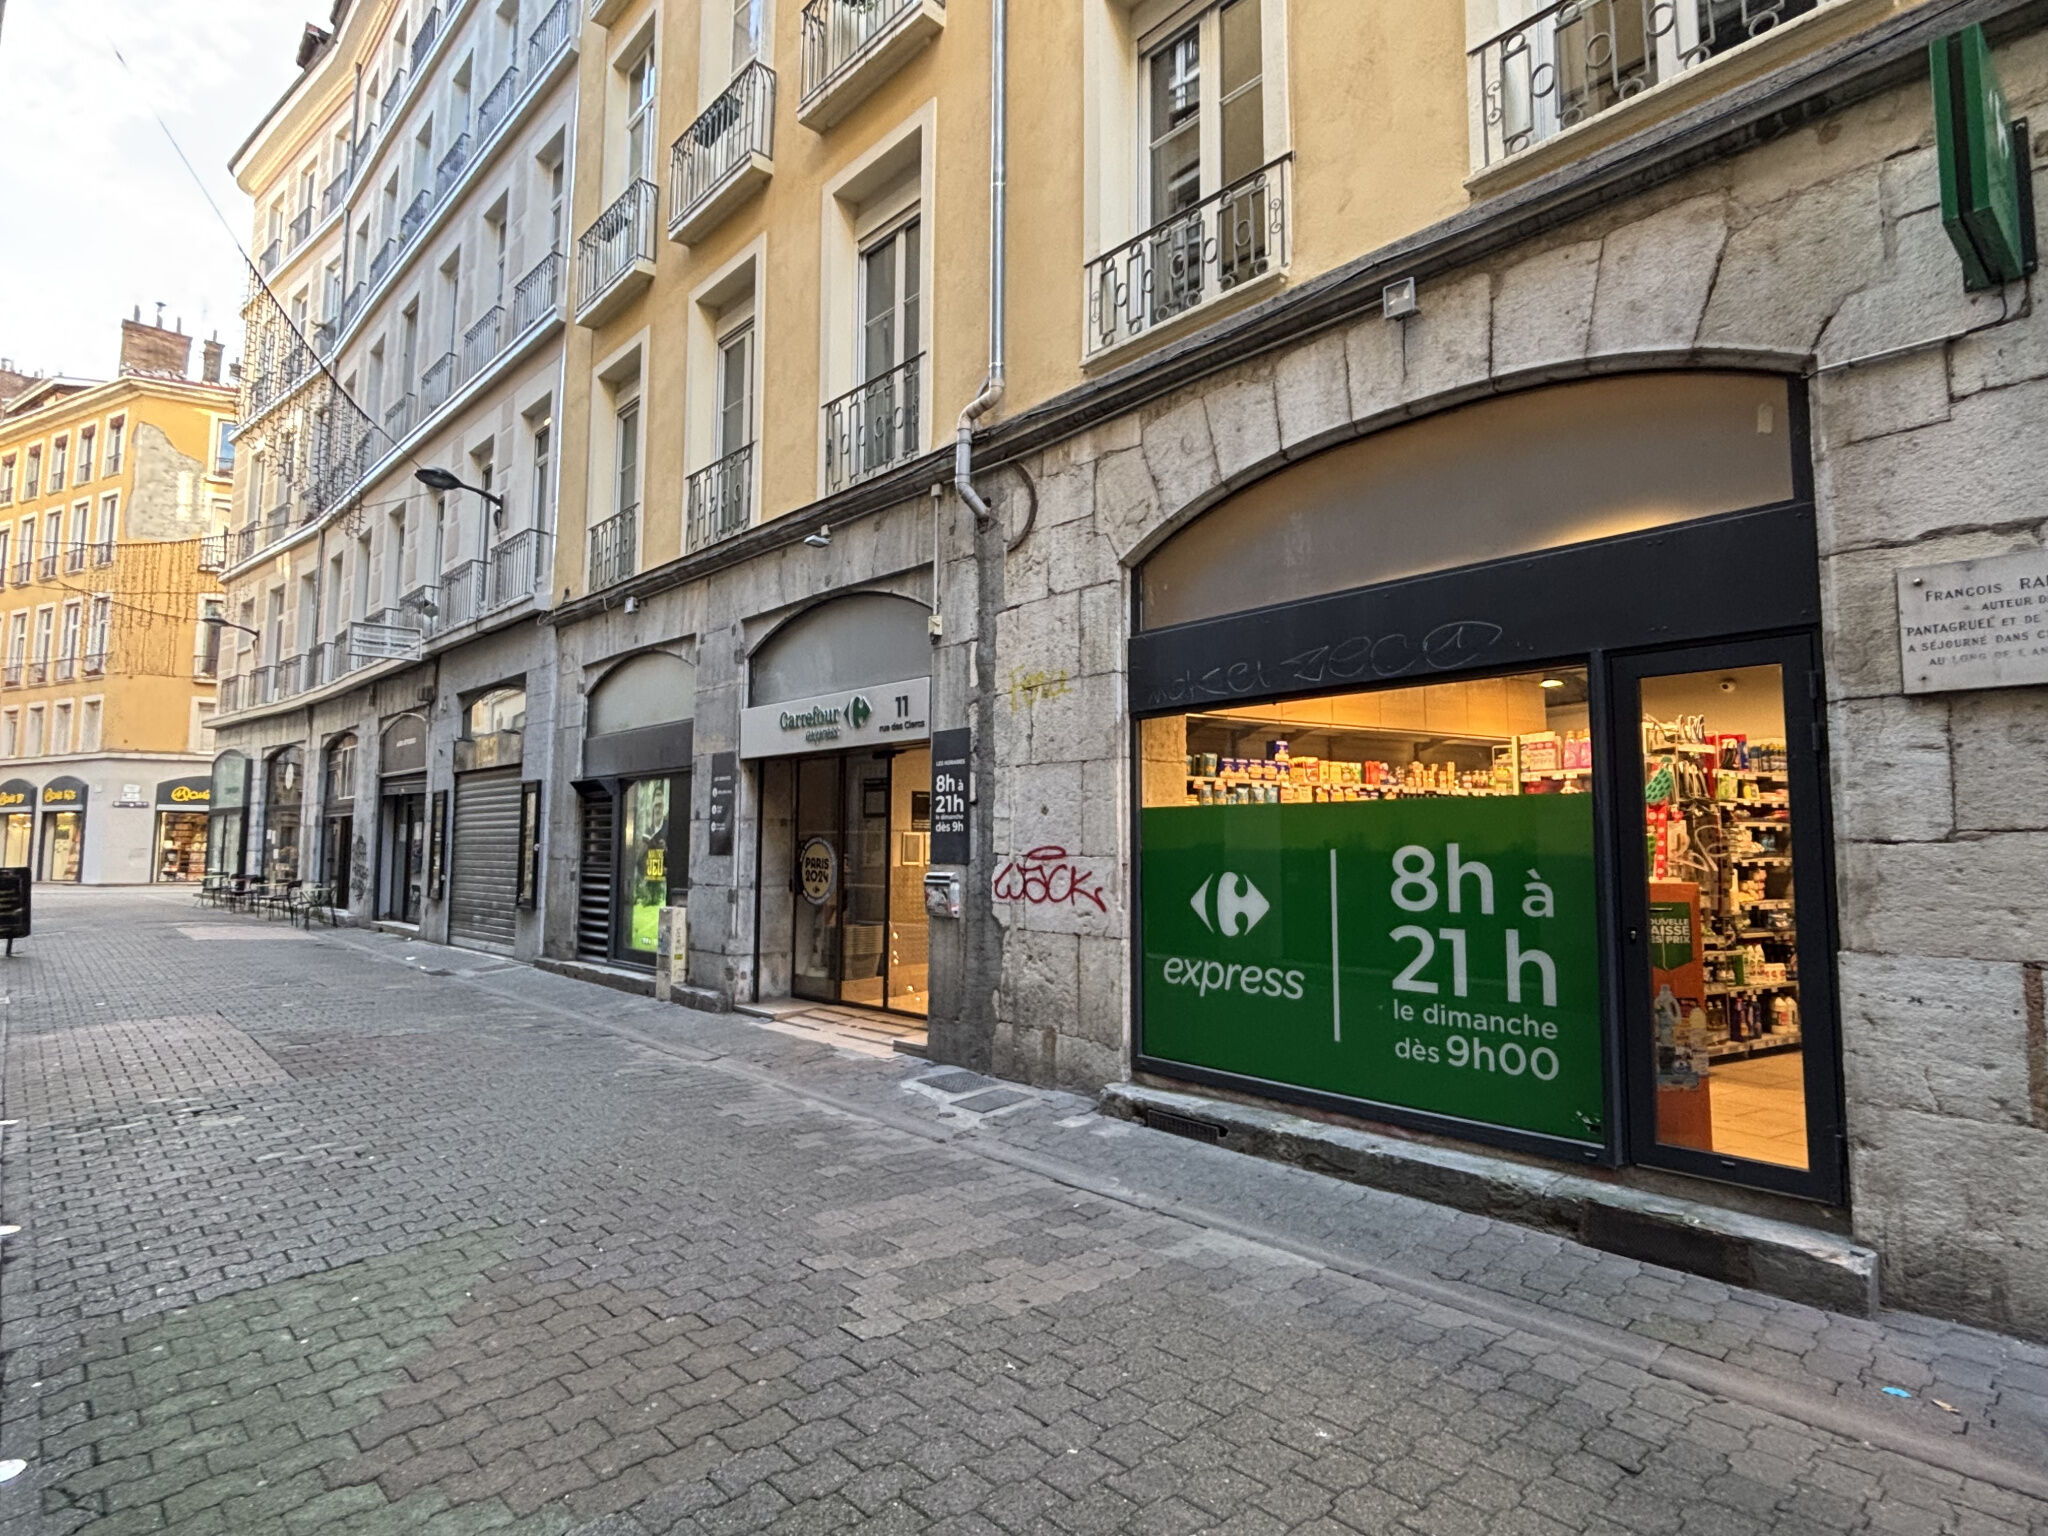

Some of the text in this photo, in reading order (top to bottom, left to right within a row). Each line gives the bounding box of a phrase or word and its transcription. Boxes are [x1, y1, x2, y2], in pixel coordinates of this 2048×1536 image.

[2019, 575, 2048, 590] RA
[1981, 594, 2048, 611] AUTEUR D
[1906, 614, 2041, 636] PANTAGRUEL ET DE
[1907, 645, 1917, 653] A
[1995, 631, 2029, 644] DANS
[2036, 629, 2048, 639] C
[1929, 657, 1946, 666] AU
[895, 695, 909, 718] 11
[780, 705, 840, 731] Carrefour
[879, 724, 890, 733] rue
[891, 722, 903, 731] des
[935, 773, 964, 793] 8h à
[935, 794, 964, 813] 21h
[935, 820, 964, 832] dès 9h
[805, 857, 829, 869] PARIS
[805, 870, 829, 882] 2024
[1390, 843, 1555, 918] 8h à
[1666, 936, 1690, 944] PRIX
[1388, 924, 1558, 1007] 21 h
[1163, 956, 1306, 1000] express
[1393, 998, 1559, 1040] le dimanche
[1394, 1035, 1560, 1081] dès 9h00
